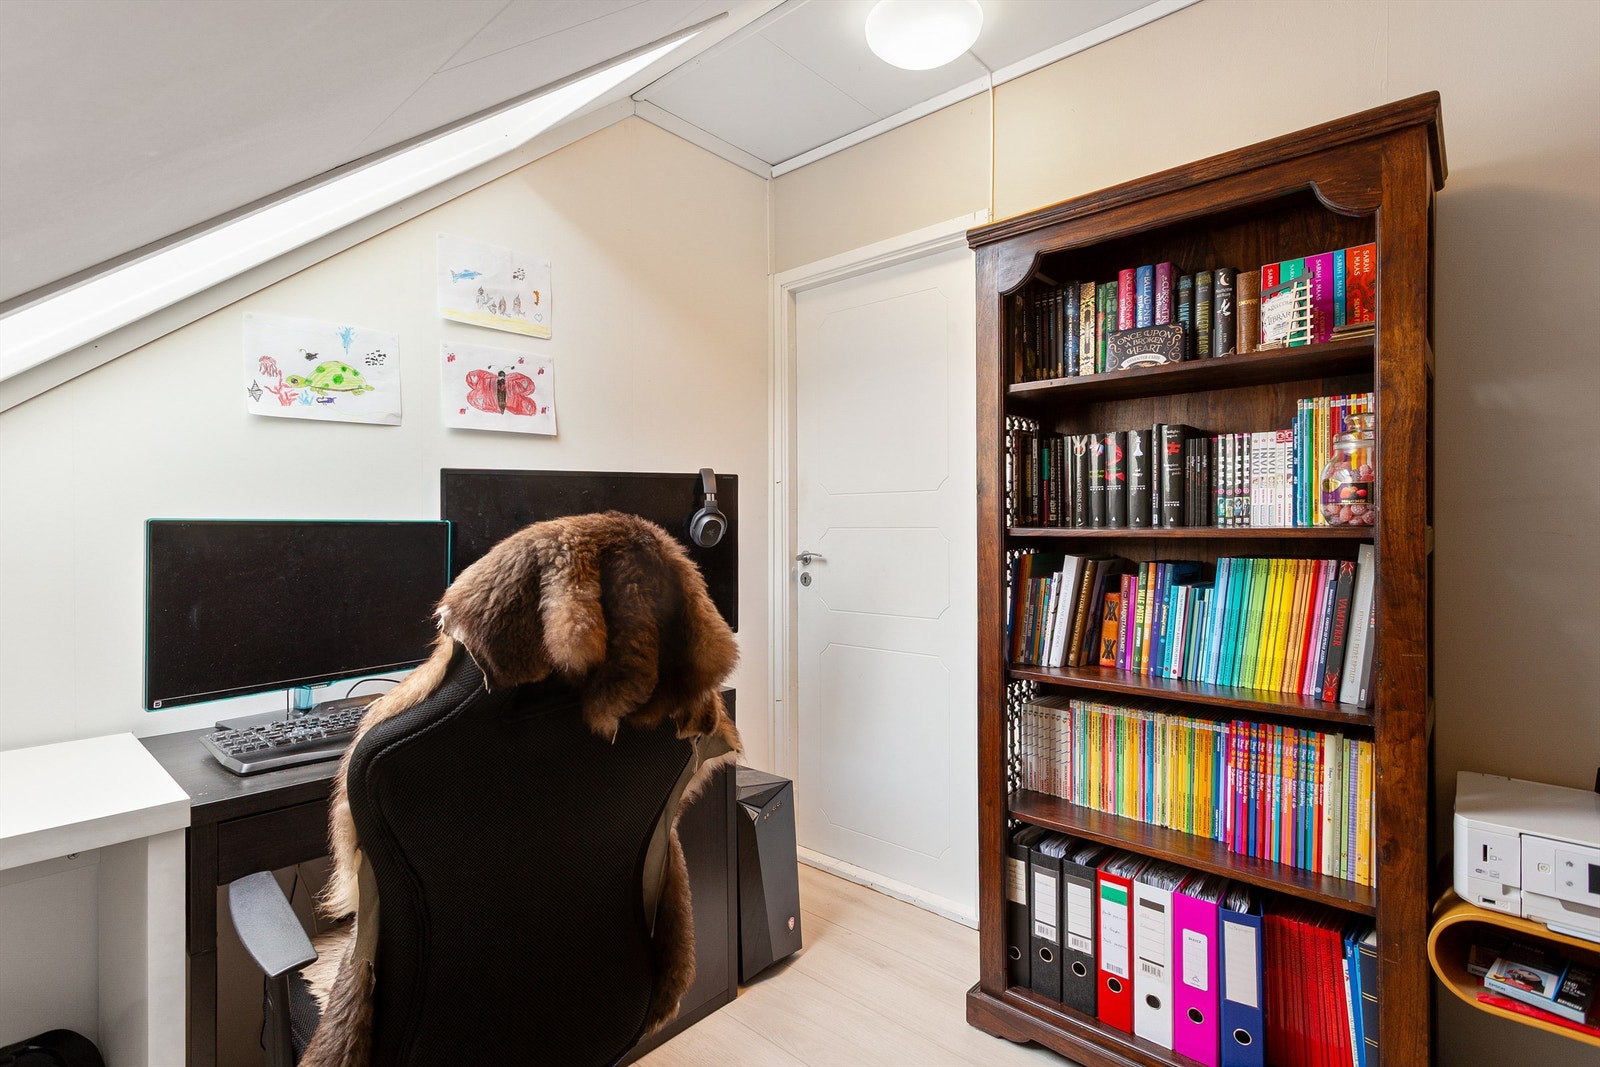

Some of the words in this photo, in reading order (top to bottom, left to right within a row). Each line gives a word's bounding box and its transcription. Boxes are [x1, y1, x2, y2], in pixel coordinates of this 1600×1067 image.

[1143, 276, 1151, 305] BALLAD
[1196, 300, 1209, 333] VAKKERT
[1117, 330, 1143, 346] ONCE
[1143, 329, 1173, 340] UPON
[1133, 337, 1165, 346] BROKEN
[1196, 335, 1209, 355] KAOS
[1126, 344, 1163, 355] HEART
[1252, 448, 1260, 475] INVU
[1260, 447, 1268, 474] INVU
[1268, 447, 1276, 474] INVU
[1137, 589, 1146, 604] VILLE
[1135, 605, 1145, 624] POTER
[1332, 598, 1348, 647] VAMPYRER
